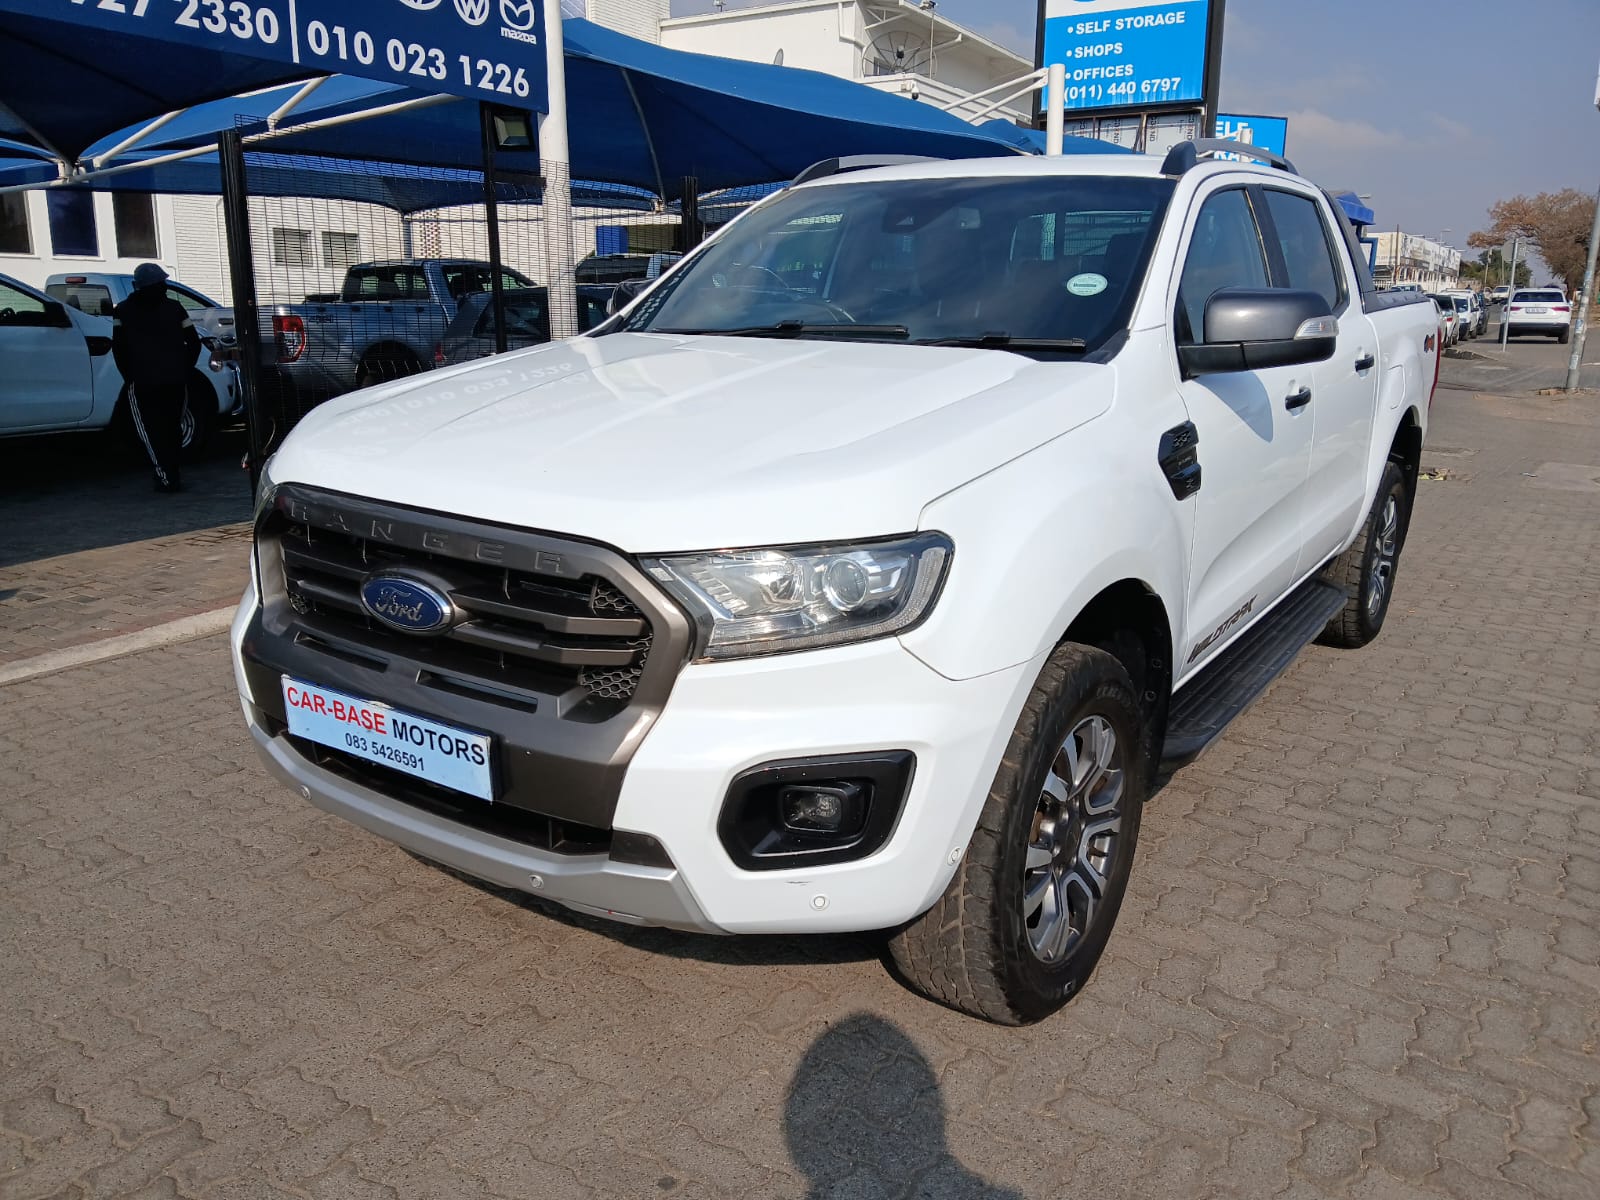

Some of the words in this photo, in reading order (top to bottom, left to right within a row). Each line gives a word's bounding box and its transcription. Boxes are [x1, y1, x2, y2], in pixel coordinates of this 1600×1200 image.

[500, 26, 537, 45] mazda
[1075, 20, 1111, 35] SELF
[1115, 11, 1186, 31] STORAGE
[173, 0, 279, 44] 2330
[307, 20, 375, 65] 010
[386, 38, 447, 80] 023
[458, 54, 530, 97] 1226
[1074, 42, 1123, 59] SHOPS
[1073, 64, 1134, 81] OFFICES
[1064, 84, 1103, 103] (011)
[1107, 81, 1137, 96] 440
[1140, 77, 1181, 94] 6797
[1215, 121, 1249, 142] ELF
[375, 586, 424, 622] Ford
[287, 686, 388, 736] CAR-BASE
[391, 718, 486, 766] MOTORS
[345, 732, 369, 752] 083
[371, 741, 425, 771] 5426591
